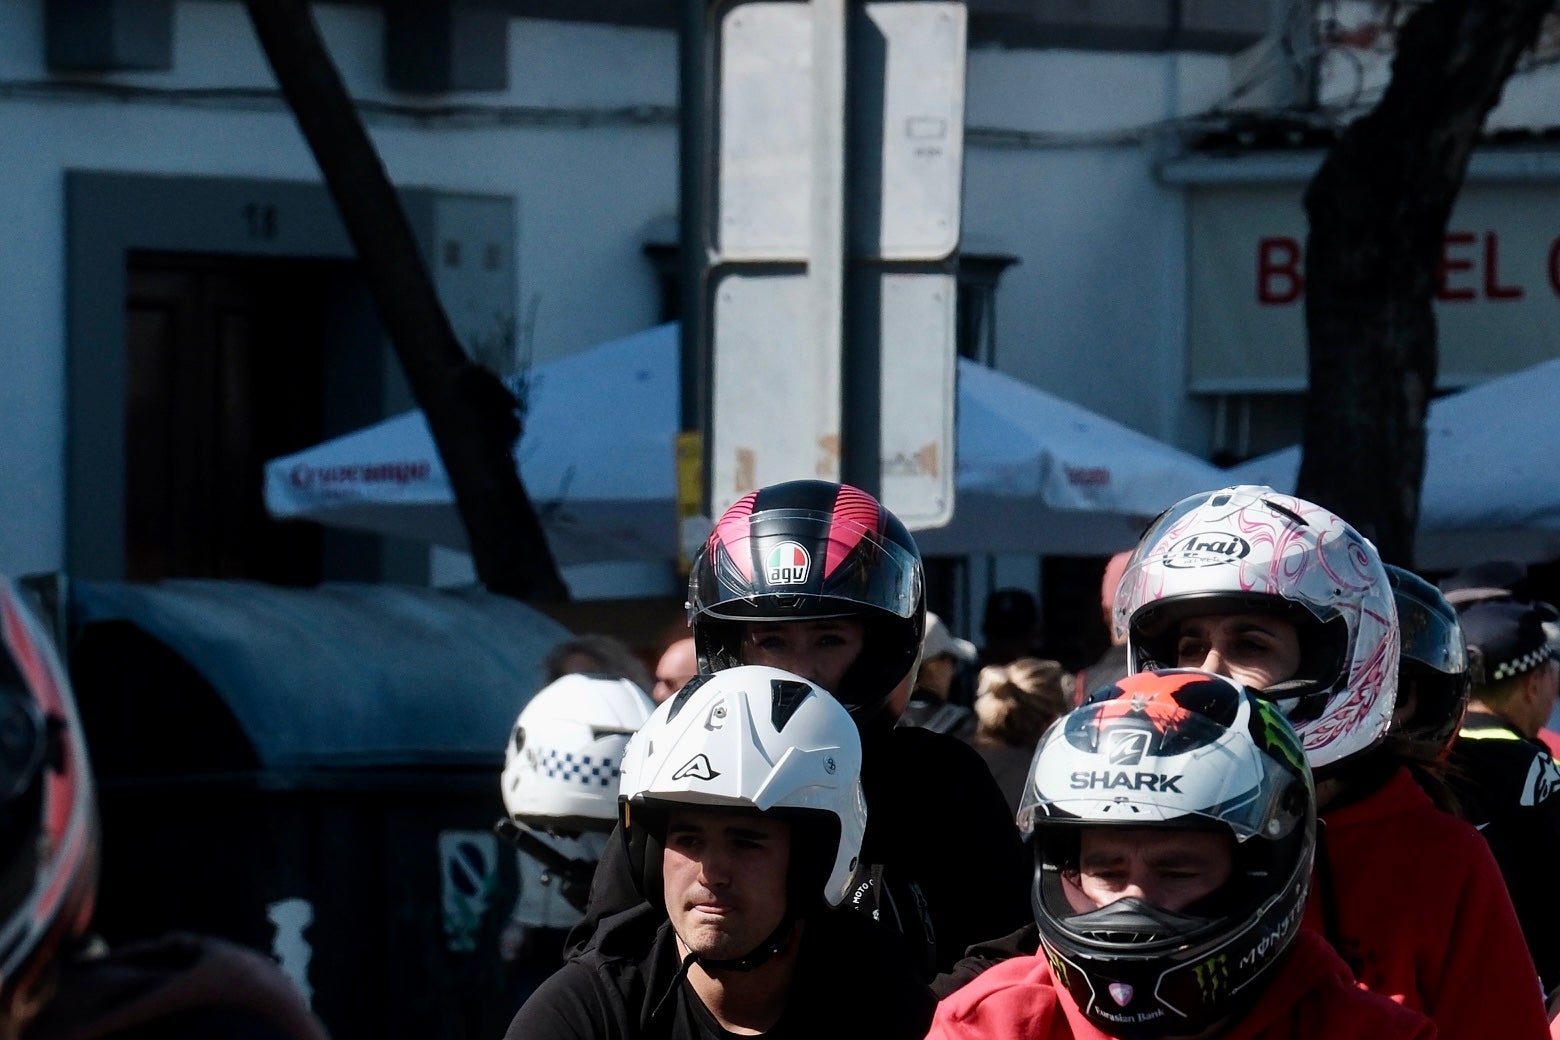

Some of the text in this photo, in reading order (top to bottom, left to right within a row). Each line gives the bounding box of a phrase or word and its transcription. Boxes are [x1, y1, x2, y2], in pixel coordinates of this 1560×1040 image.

[1437, 232, 1524, 301] EL
[1070, 770, 1184, 794] SHARK
[853, 882, 869, 904] MOTO
[1137, 1008, 1165, 1022] Bank
